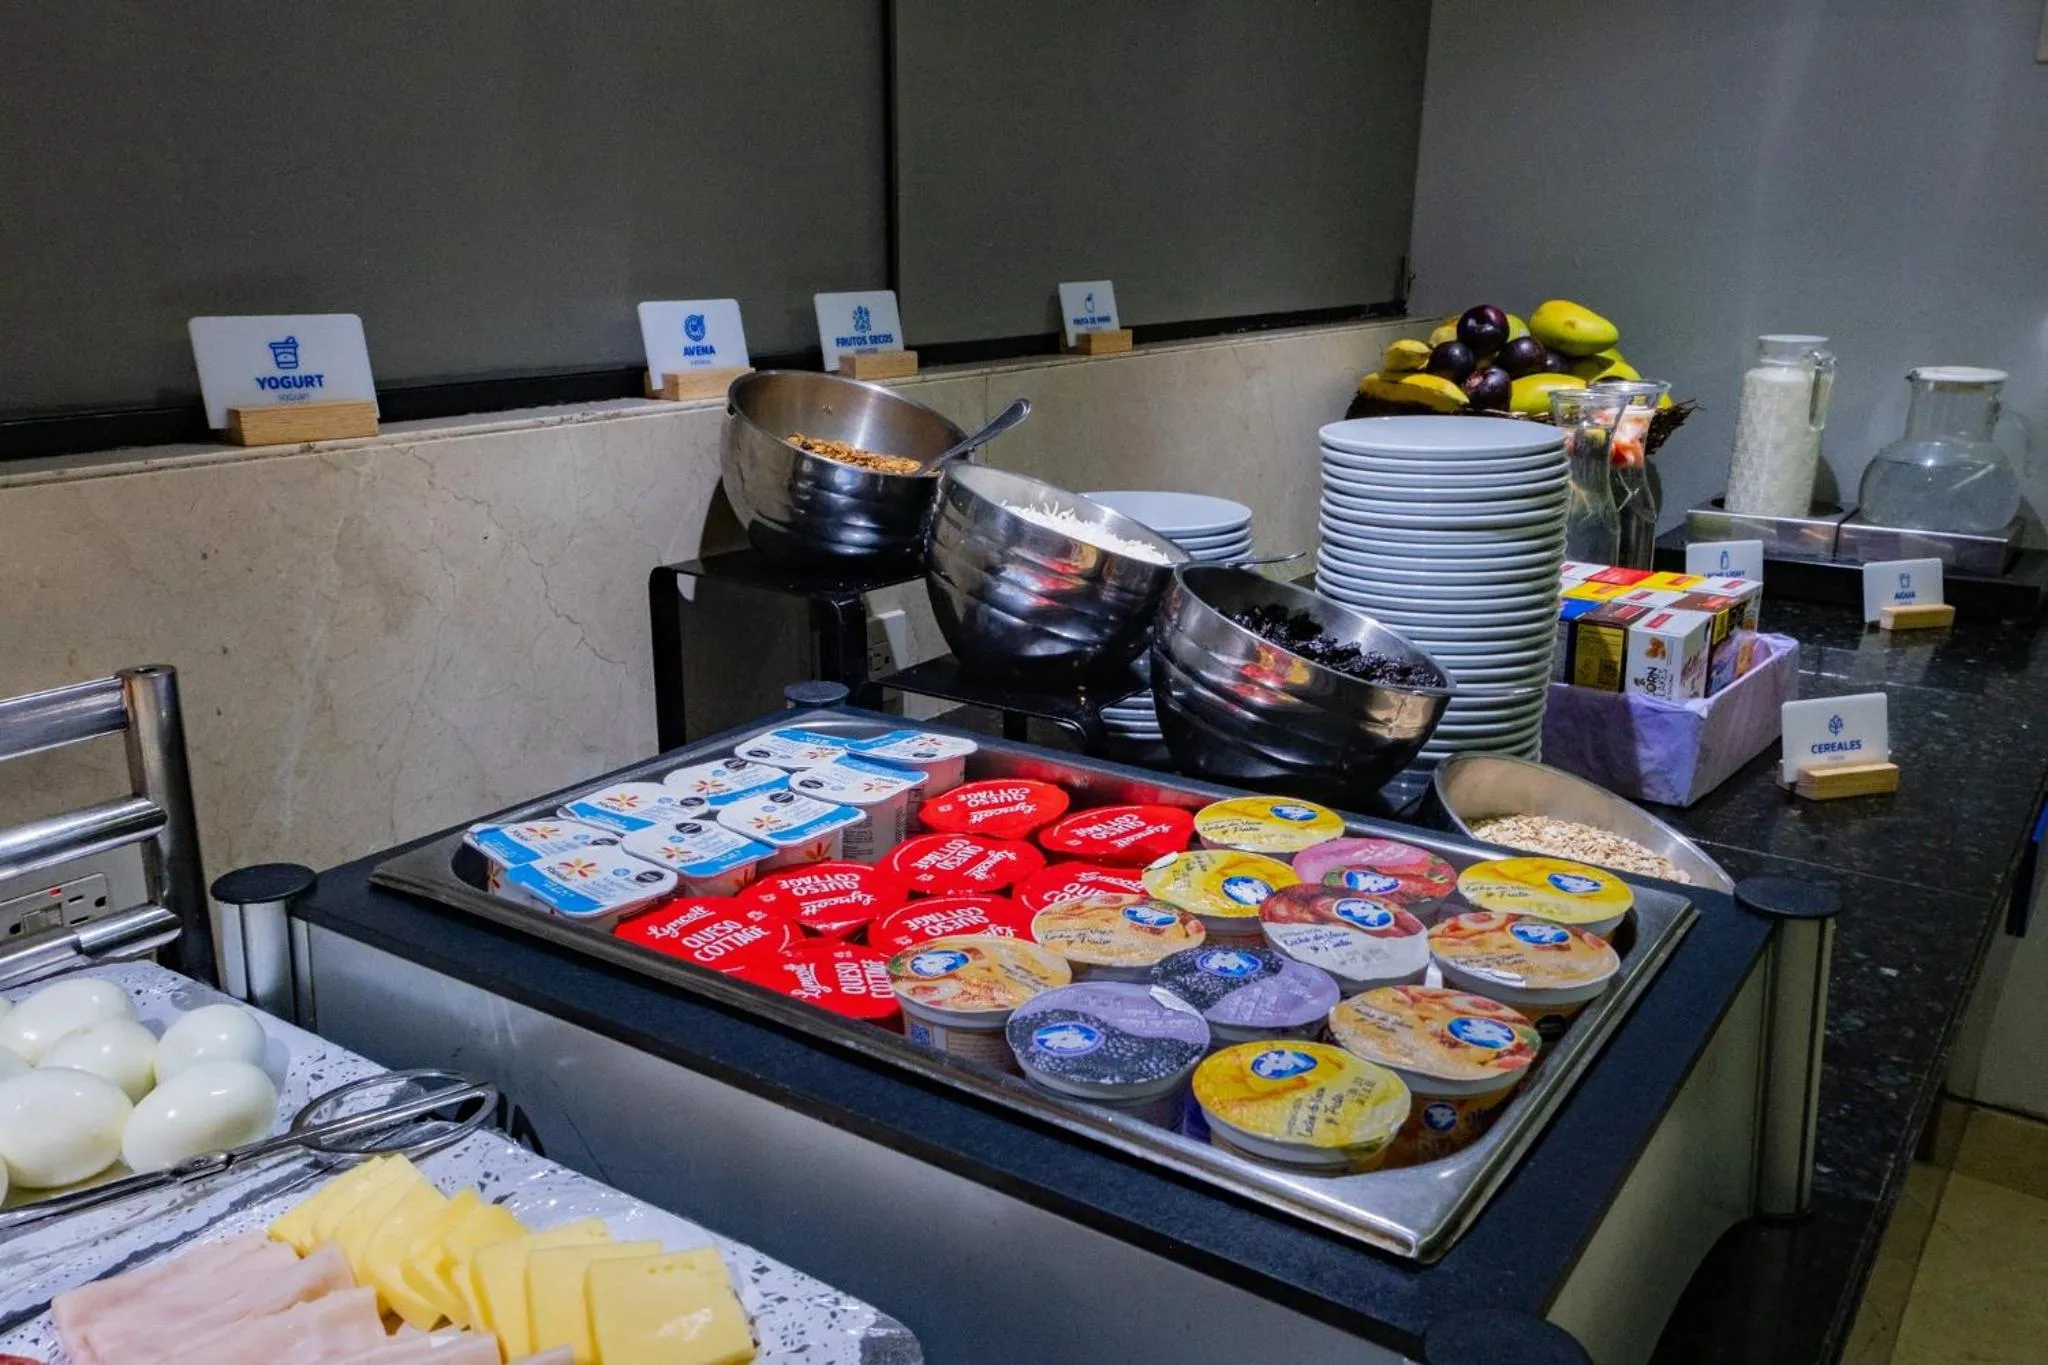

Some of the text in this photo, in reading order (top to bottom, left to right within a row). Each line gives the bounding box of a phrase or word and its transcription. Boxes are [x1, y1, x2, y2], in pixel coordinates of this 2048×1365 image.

[684, 345, 716, 356] AVENA
[836, 333, 893, 347] FRUTOS SECOS
[255, 373, 325, 390] YOGURT
[1894, 591, 1916, 600] AGUA
[1811, 739, 1863, 755] CEREALES
[957, 787, 1030, 802] COTTAGE
[967, 793, 1027, 808] QUESO
[969, 802, 1038, 825] Lyncott
[1069, 813, 1140, 838] COTTAGE
[1090, 819, 1147, 840] QUESO
[1109, 823, 1173, 848] Lyncott
[910, 838, 971, 871] COTTAGE
[936, 844, 984, 871] QUESO
[963, 849, 1017, 881] Lyncott
[777, 872, 861, 890] COTTAGE
[791, 880, 860, 897] QUESO
[800, 890, 877, 917] Lyncott
[647, 904, 717, 940] Lyncott
[901, 906, 985, 932] COTTAGE
[924, 914, 990, 937] QUESO
[681, 919, 743, 949] QUESO
[693, 924, 771, 962] COTTAGE
[1320, 939, 1353, 952] Futa
[783, 962, 833, 1000] Lyncott
[834, 961, 867, 995] QUESO
[860, 959, 896, 999] COTTAGE
